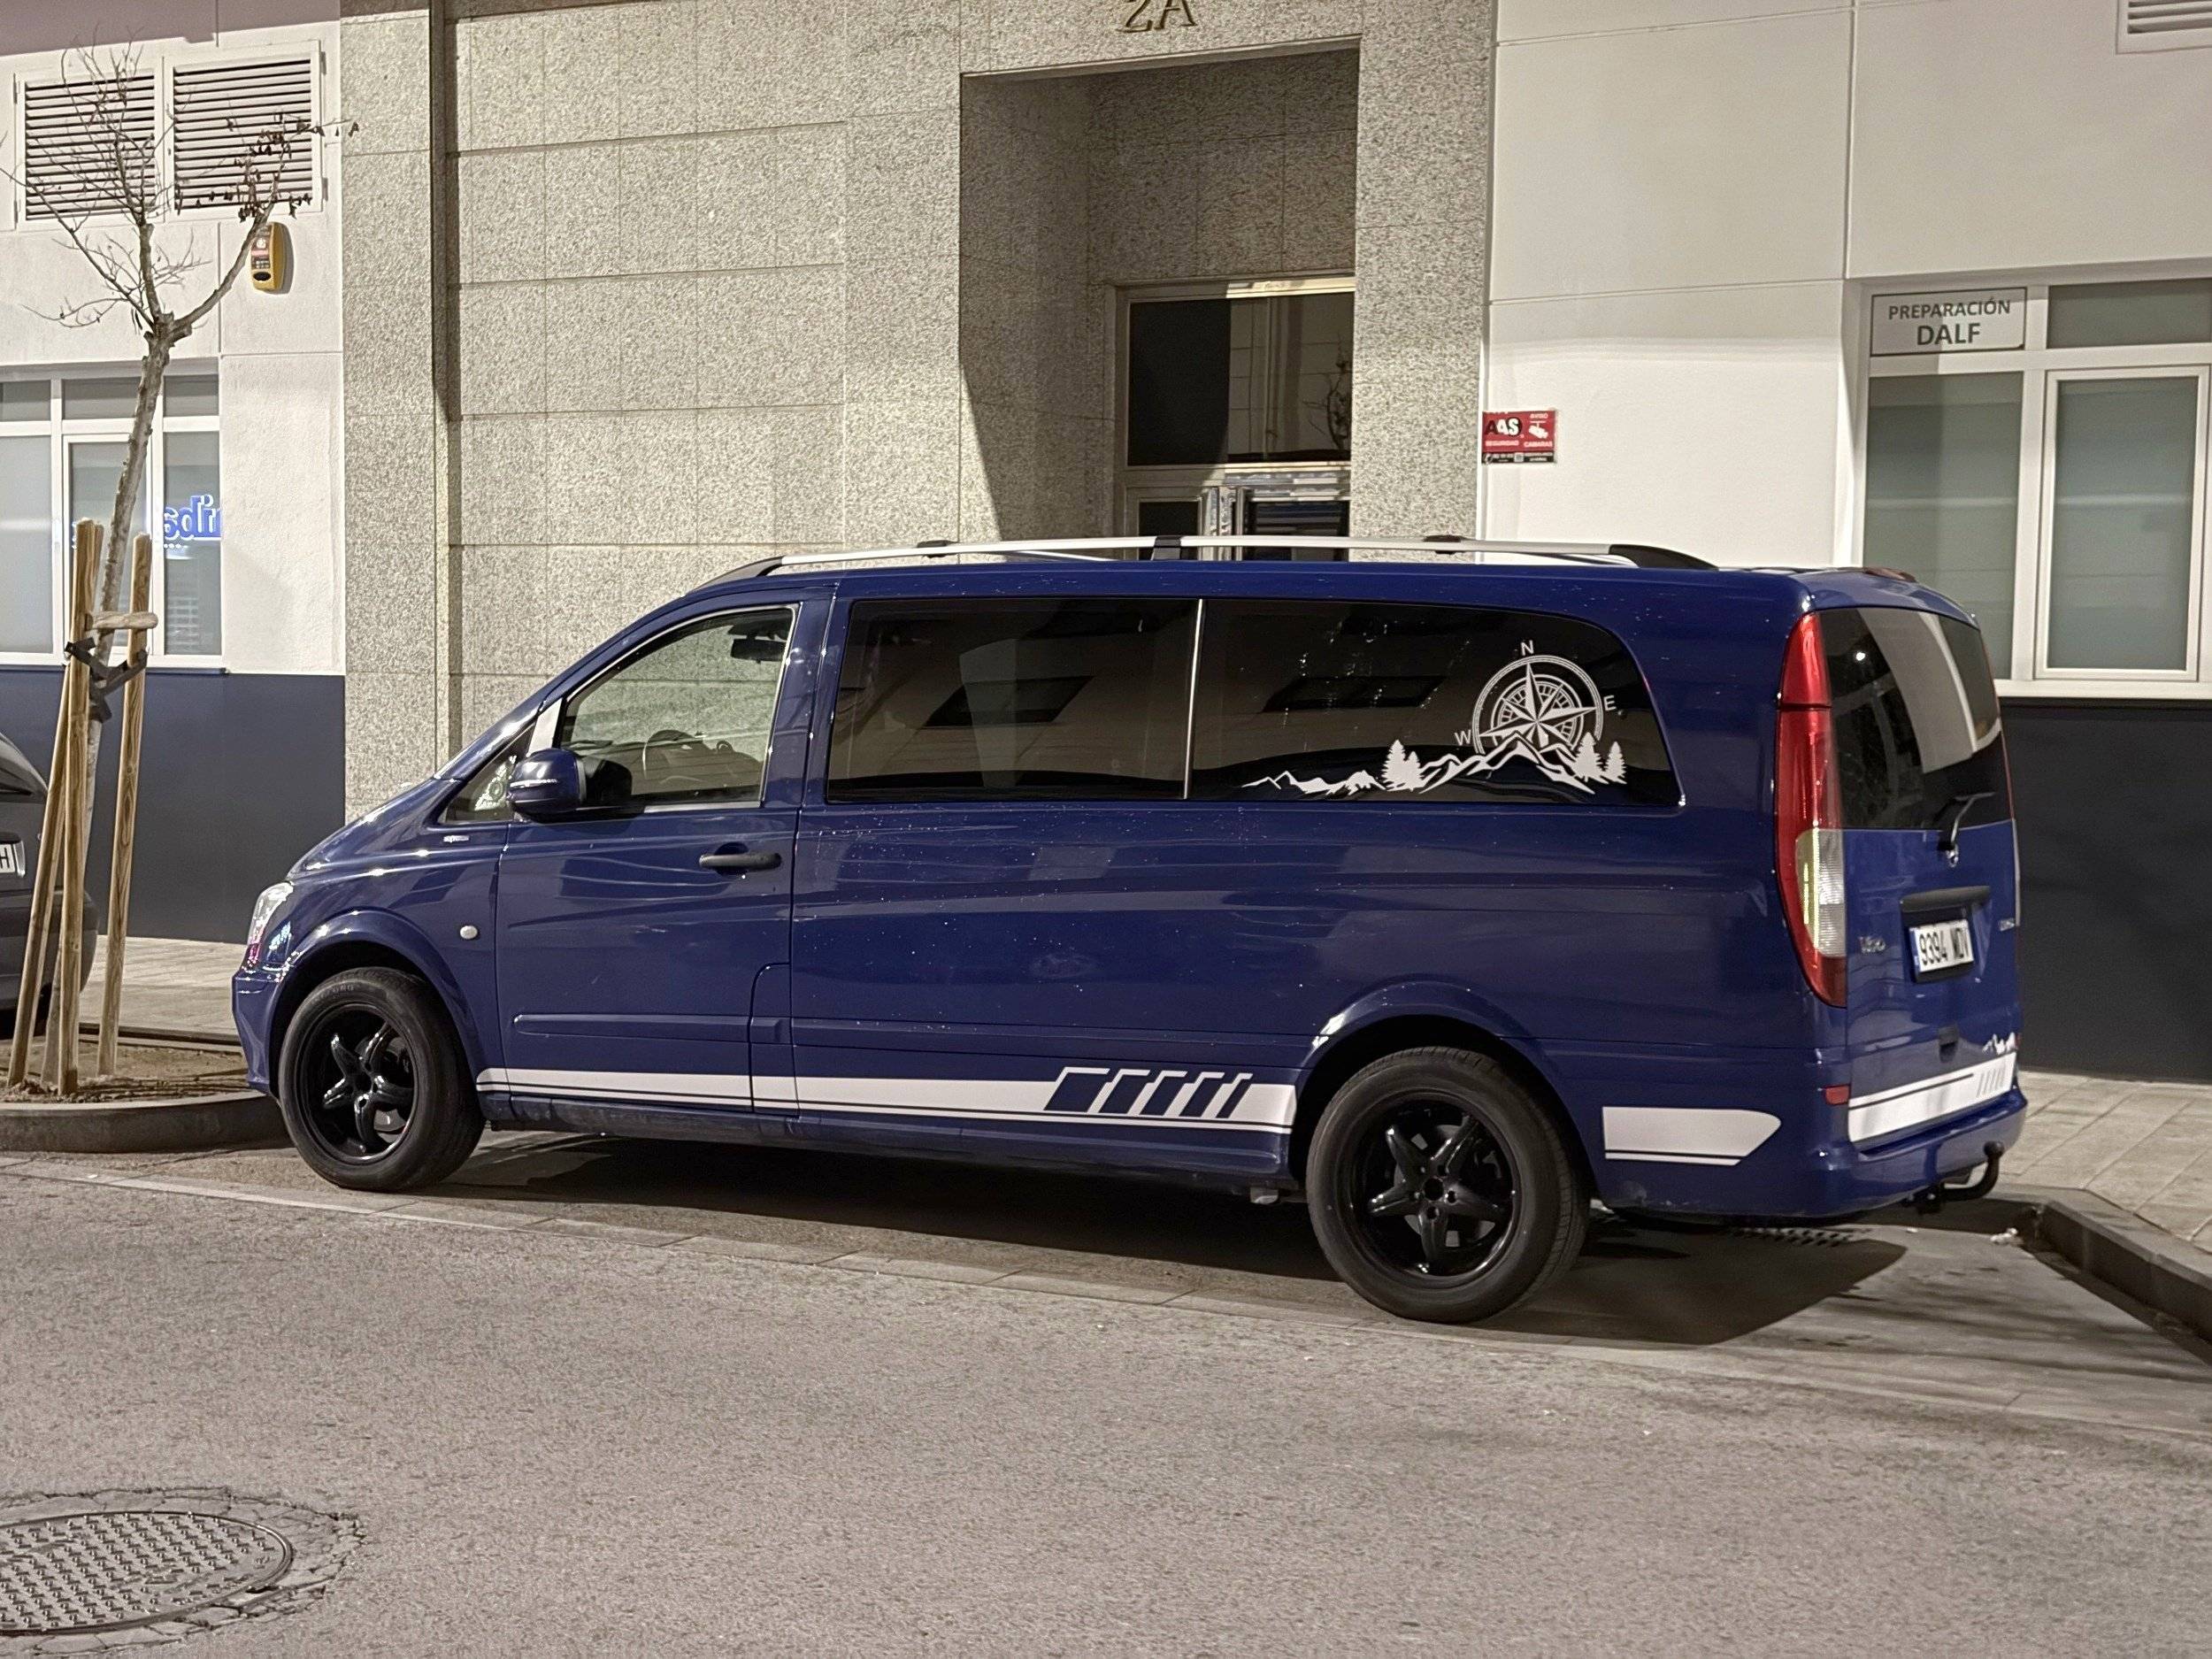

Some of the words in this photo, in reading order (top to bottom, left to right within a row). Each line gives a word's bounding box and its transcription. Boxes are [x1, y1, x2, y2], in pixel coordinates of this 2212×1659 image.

[1888, 296, 2010, 320] PREPARACIÓN
[1916, 323, 1981, 346] DALF
[1520, 640, 1535, 657] N
[1603, 695, 1617, 711] E
[1454, 729, 1472, 747] W
